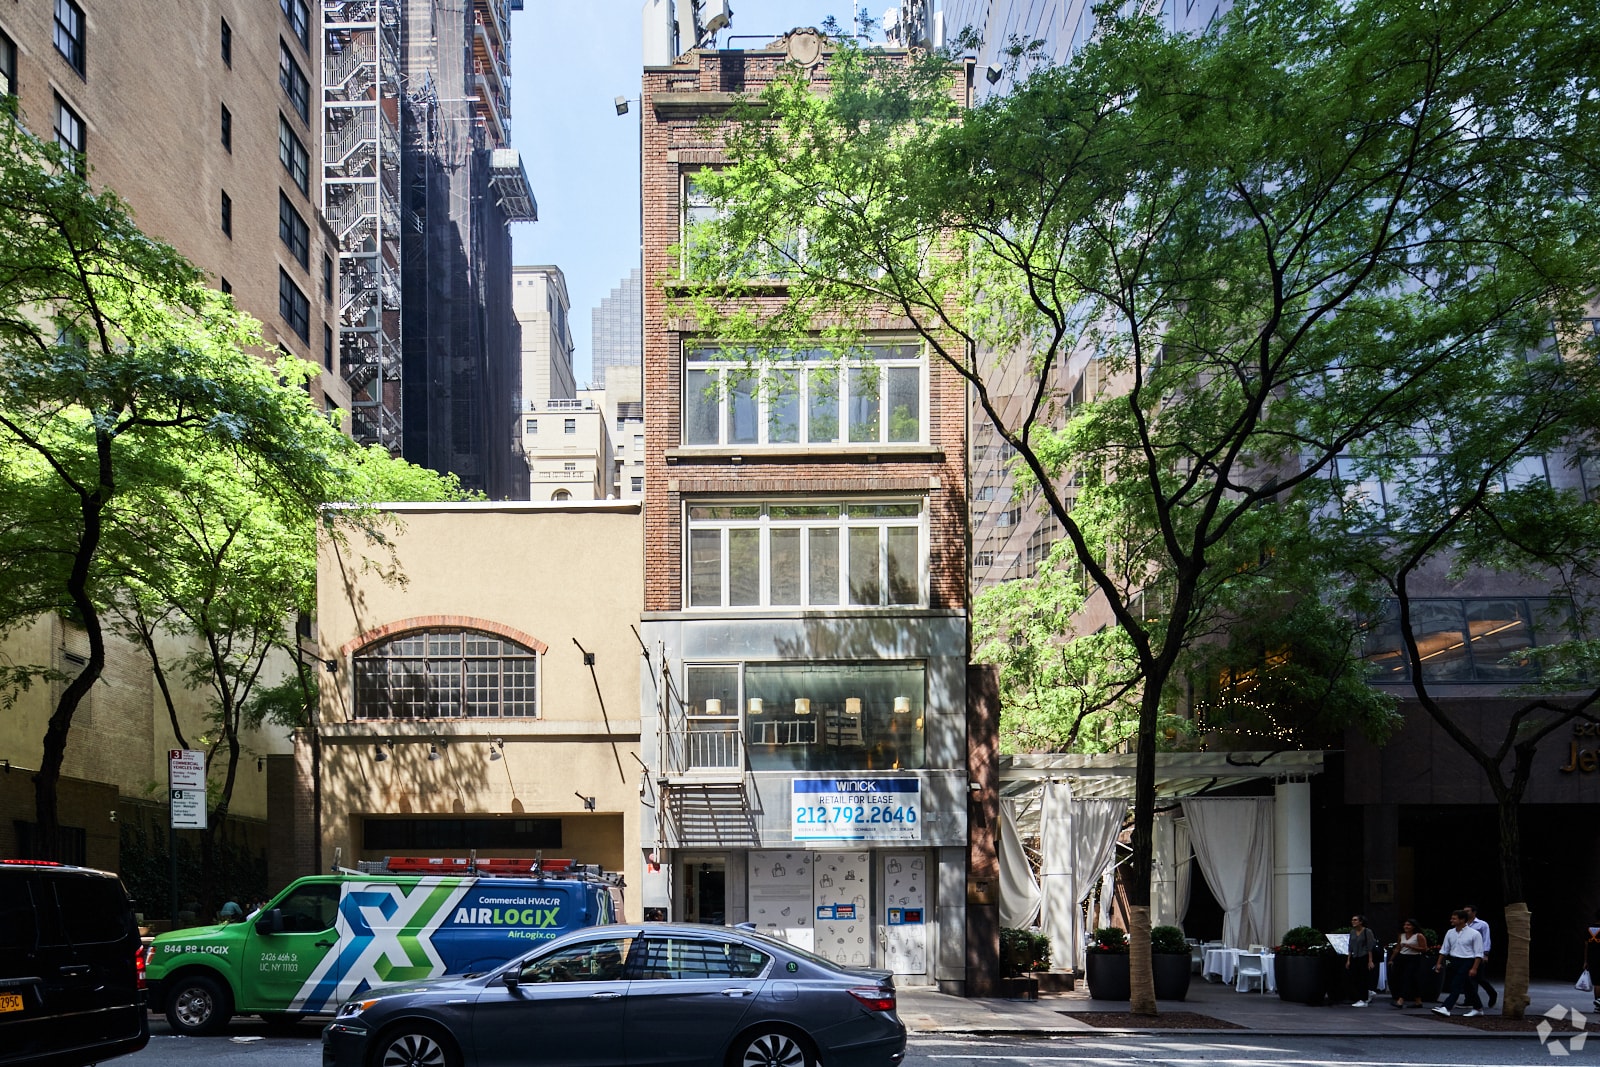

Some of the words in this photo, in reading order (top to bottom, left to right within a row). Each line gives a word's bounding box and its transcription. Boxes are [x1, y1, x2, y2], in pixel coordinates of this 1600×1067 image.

[174, 750, 180, 759] 3
[1560, 739, 1600, 772] Je
[835, 781, 876, 791] WINICK
[174, 790, 181, 799] 6
[819, 796, 846, 804] RETAIL
[848, 796, 865, 804] FOR
[867, 796, 893, 804] LEASE
[796, 806, 917, 823] 212.792.2646
[479, 896, 527, 905] Commercial
[528, 897, 561, 906] HVAC/R
[454, 907, 561, 928] AIRLOGIX
[507, 930, 556, 940] AirLogix.co
[164, 945, 181, 953] 844
[184, 945, 197, 954] 88
[200, 945, 229, 955] LOGIX
[261, 952, 276, 961] 2426
[277, 953, 290, 962] 46th
[271, 963, 282, 971] NY
[282, 964, 298, 972] 11103
[0, 996, 20, 1009] 295C
